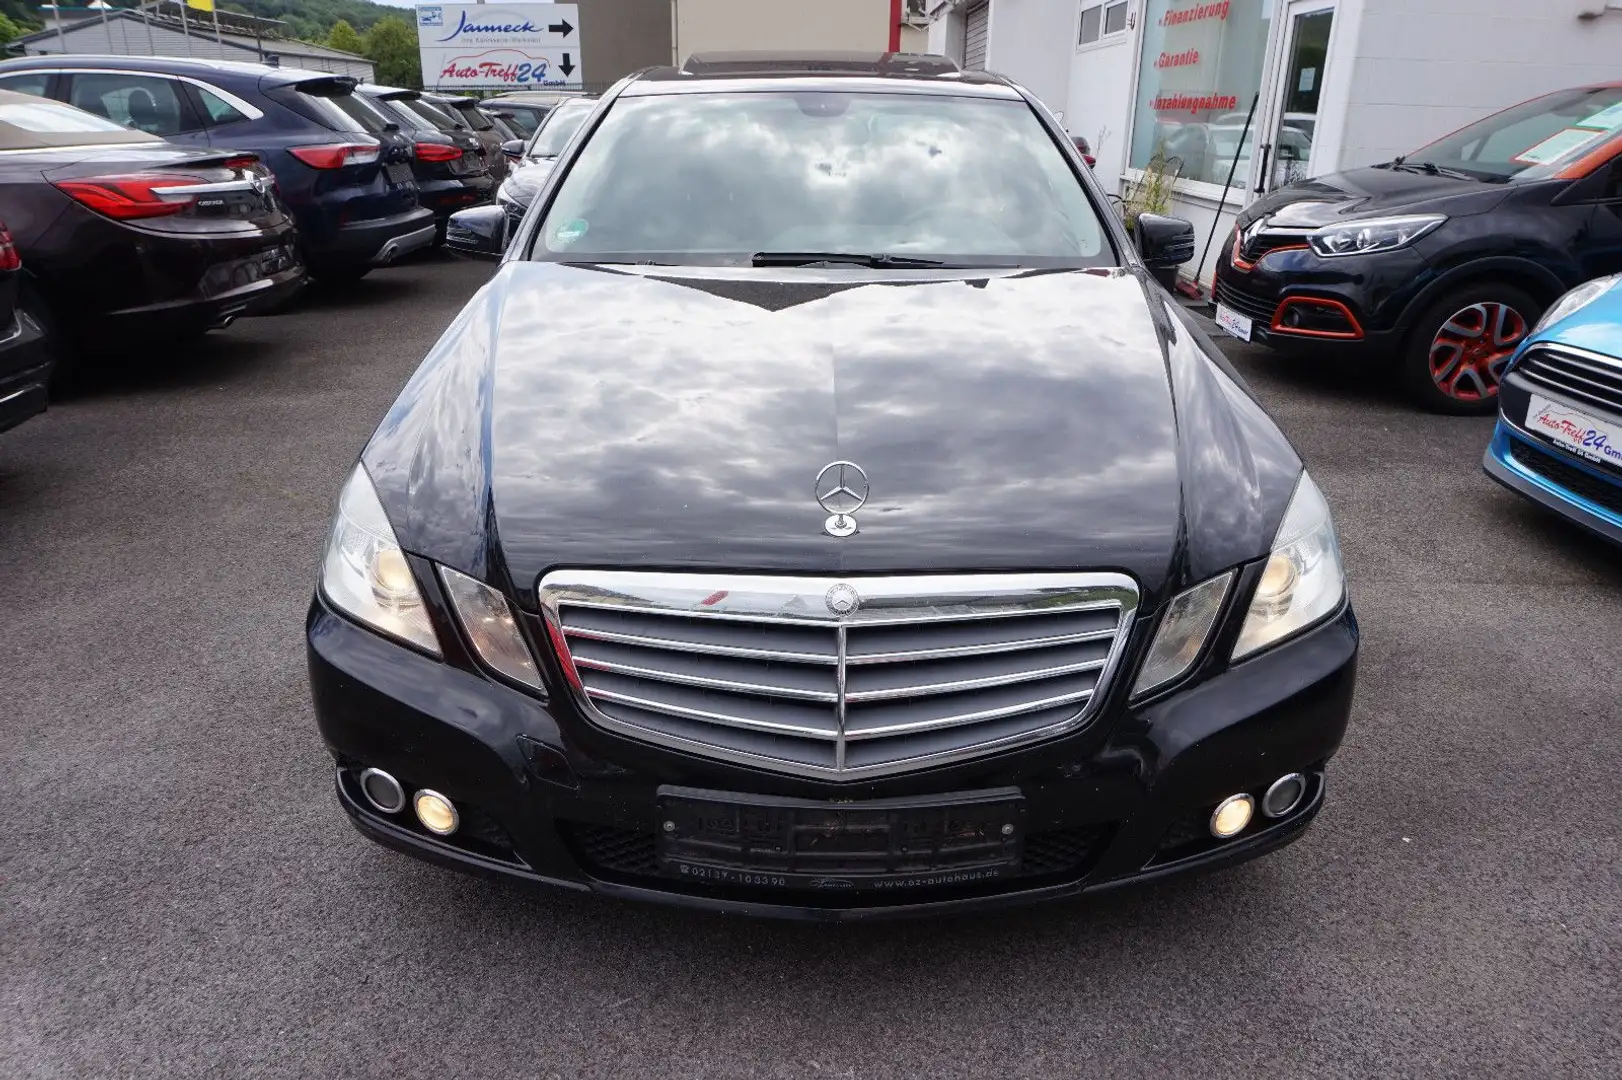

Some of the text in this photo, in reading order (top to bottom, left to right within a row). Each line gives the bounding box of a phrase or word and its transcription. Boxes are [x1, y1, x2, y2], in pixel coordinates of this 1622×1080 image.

[1164, 0, 1229, 26] Finanzierung
[1159, 48, 1199, 68] Garantie
[1153, 92, 1236, 114] Inzahlungnahme
